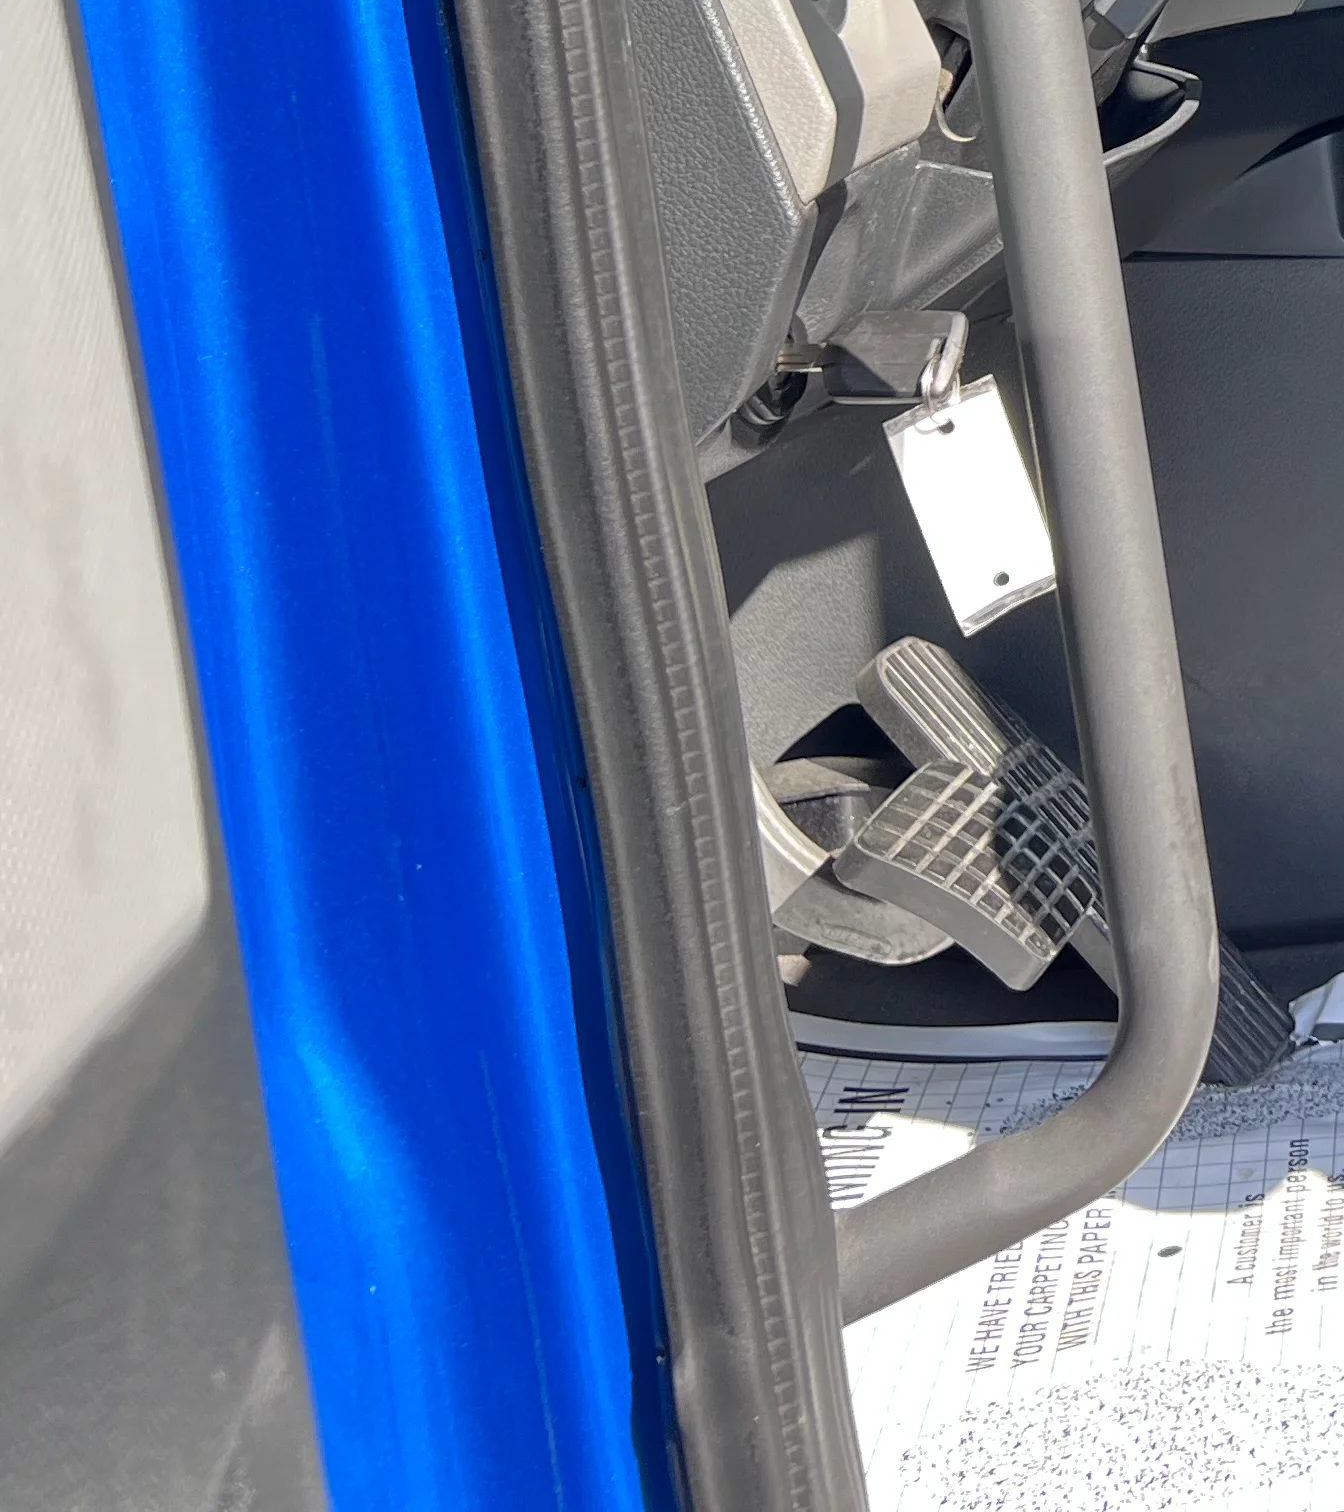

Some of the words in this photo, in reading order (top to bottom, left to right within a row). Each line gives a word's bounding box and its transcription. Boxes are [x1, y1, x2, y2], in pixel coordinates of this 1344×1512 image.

[834, 1086, 910, 1113] IN
[1286, 1138, 1311, 1193] person
[1238, 1193, 1265, 1209] is
[1321, 1197, 1344, 1212] to
[1077, 1208, 1114, 1264] PAPER
[1233, 1214, 1263, 1272] customer
[1272, 1198, 1307, 1262] important
[1317, 1213, 1344, 1250] world
[1227, 1274, 1254, 1285] A
[1312, 1251, 1340, 1271] the
[1068, 1269, 1103, 1306] THIS
[1272, 1264, 1298, 1301] most
[1310, 1275, 1339, 1292] in
[974, 1297, 1012, 1341] HAVE
[1056, 1306, 1095, 1352] WITH
[1265, 1307, 1294, 1336] the
[965, 1344, 1000, 1373] WE
[1010, 1321, 1049, 1369] YOUR
